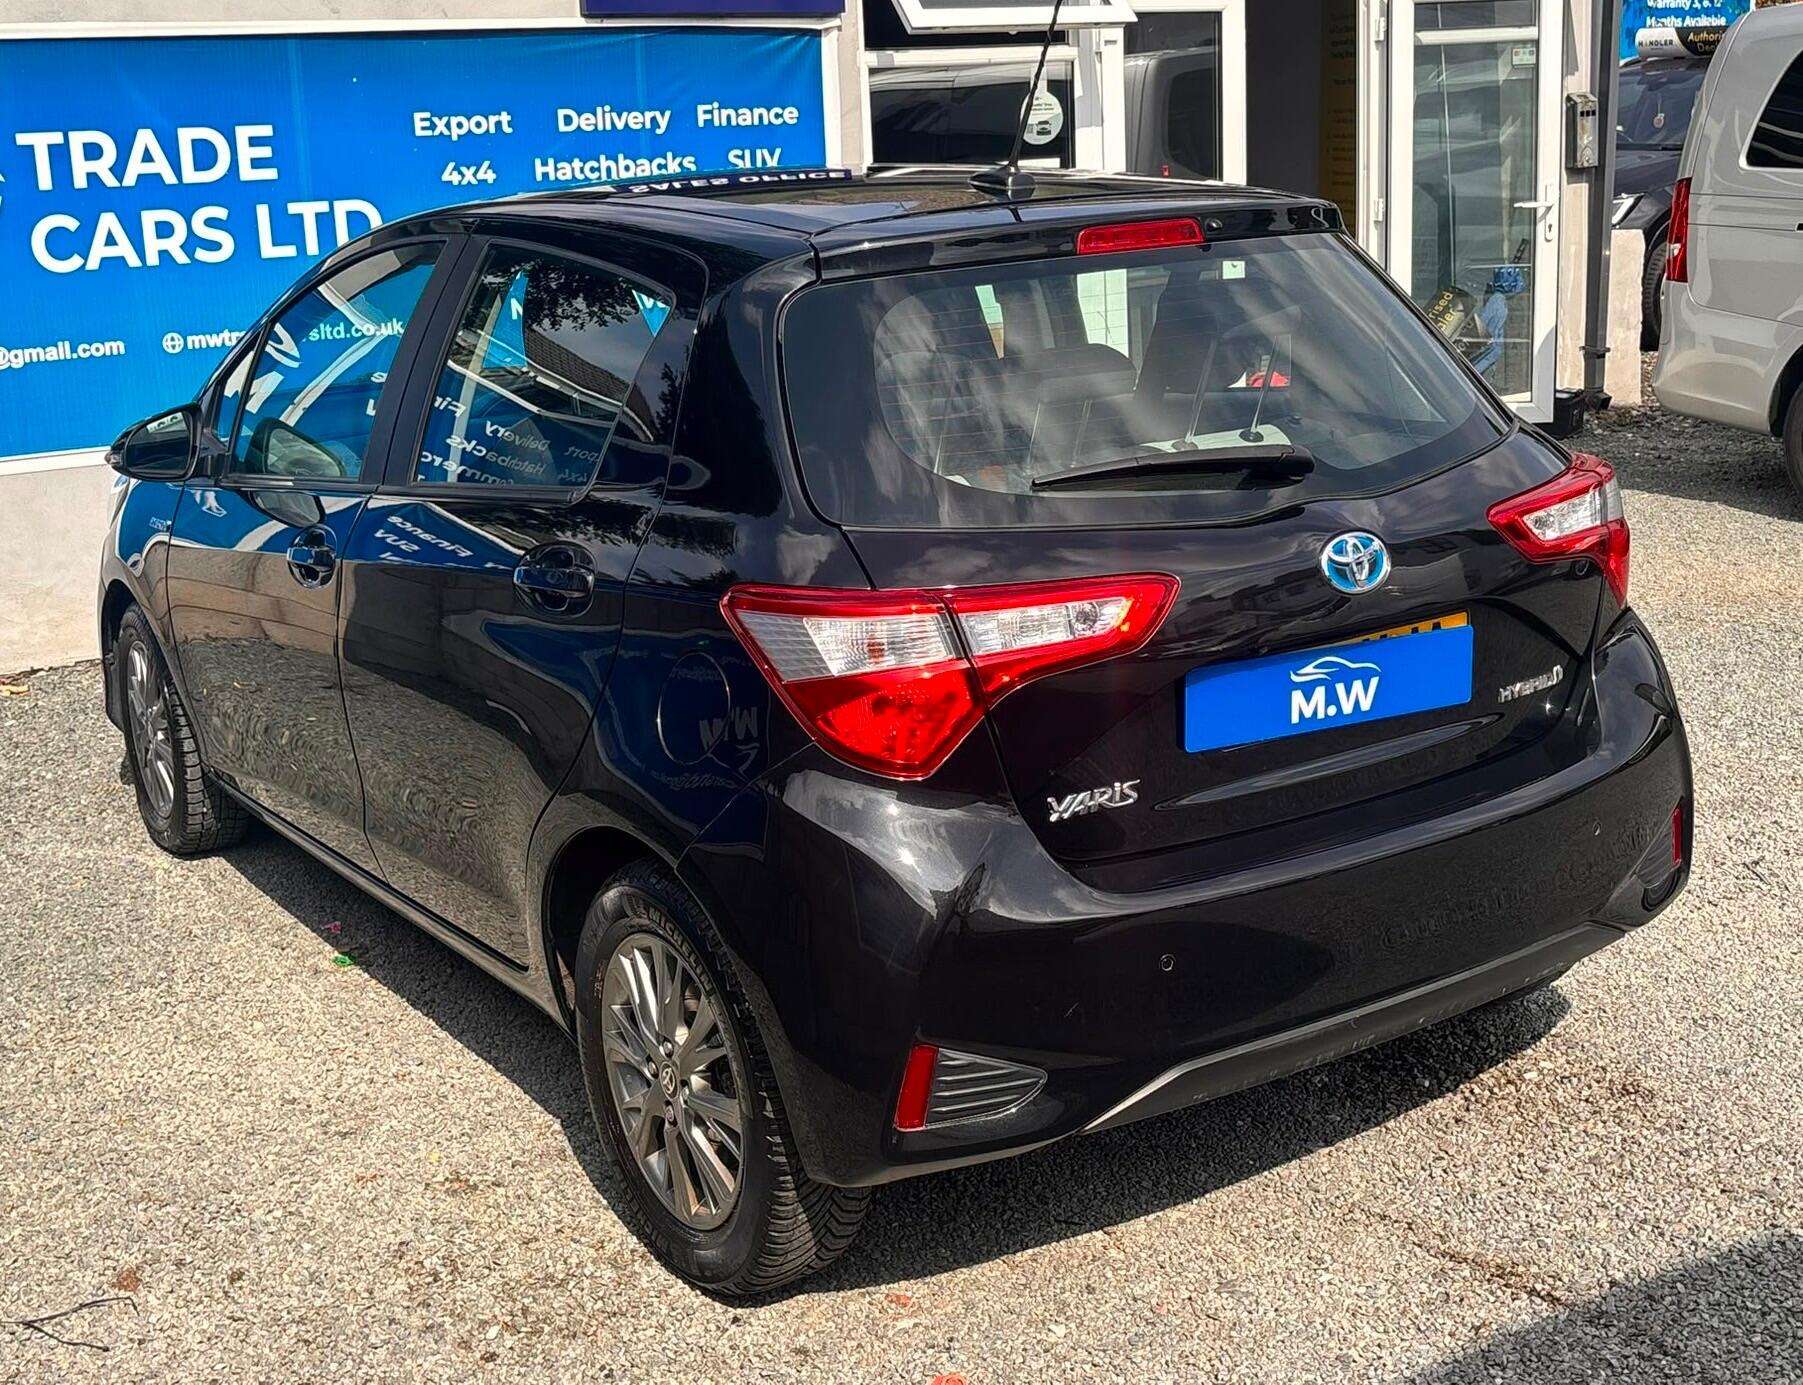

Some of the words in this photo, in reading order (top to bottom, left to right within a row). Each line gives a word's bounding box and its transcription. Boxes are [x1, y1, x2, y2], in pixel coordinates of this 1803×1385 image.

[414, 110, 513, 141] Export
[556, 105, 672, 135] Delivery
[697, 101, 799, 128] Finance
[15, 124, 279, 193] TRADE
[441, 160, 497, 187] 4x4
[535, 151, 696, 182] Hatchbacks
[728, 148, 782, 169] SUV
[31, 204, 236, 274] CARS
[257, 198, 383, 261] LTD
[1047, 780, 1141, 823] YARIS
